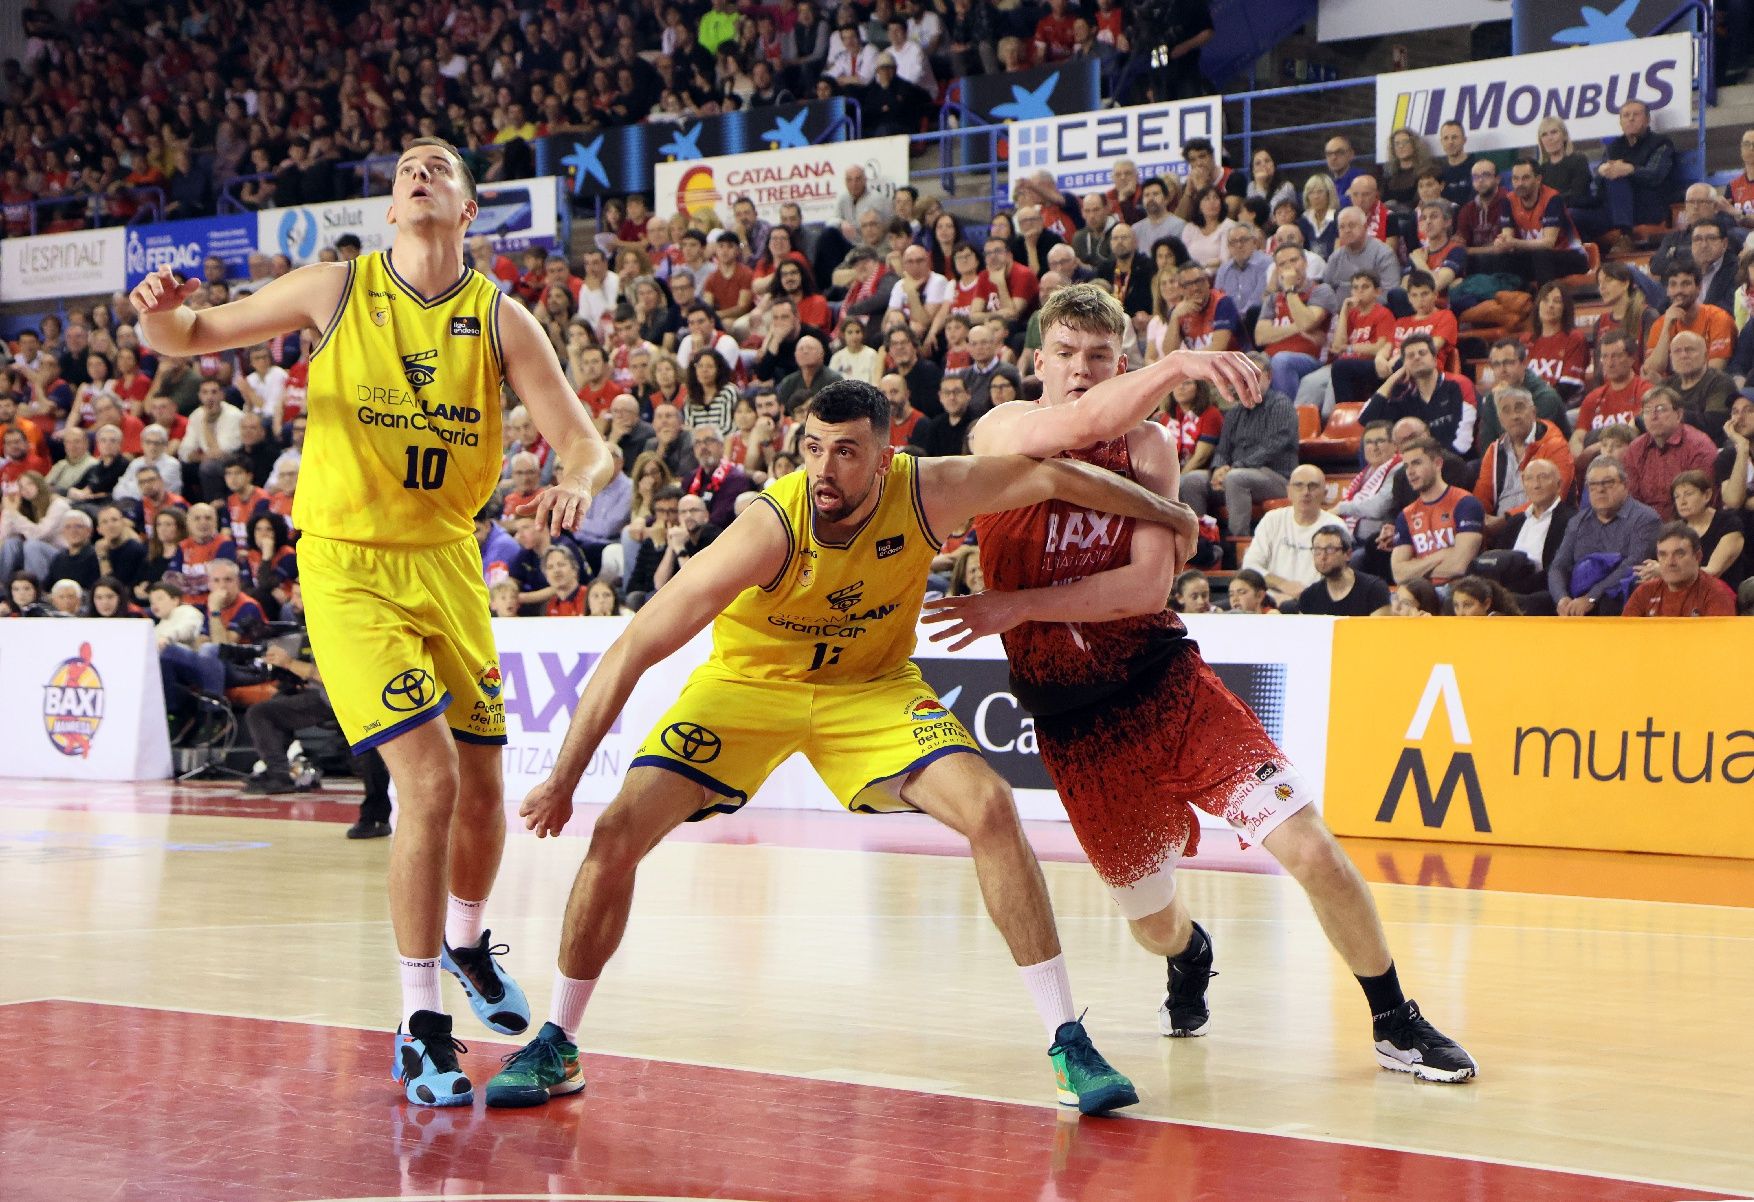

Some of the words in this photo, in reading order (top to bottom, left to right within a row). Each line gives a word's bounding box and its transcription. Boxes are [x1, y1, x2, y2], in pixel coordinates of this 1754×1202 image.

[1454, 59, 1677, 131] MONBUS
[726, 161, 835, 187] CATALANA
[757, 181, 836, 201] TREBALL
[323, 206, 363, 228] Salut
[146, 242, 200, 271] FEDAC
[1527, 358, 1564, 379] AXI
[403, 445, 448, 491] 10
[1413, 527, 1456, 554] BAXI
[45, 686, 104, 718] BAXI
[470, 712, 491, 725] del
[918, 731, 939, 746] del
[1513, 717, 1754, 784] mutua
[1260, 767, 1274, 780] acb
